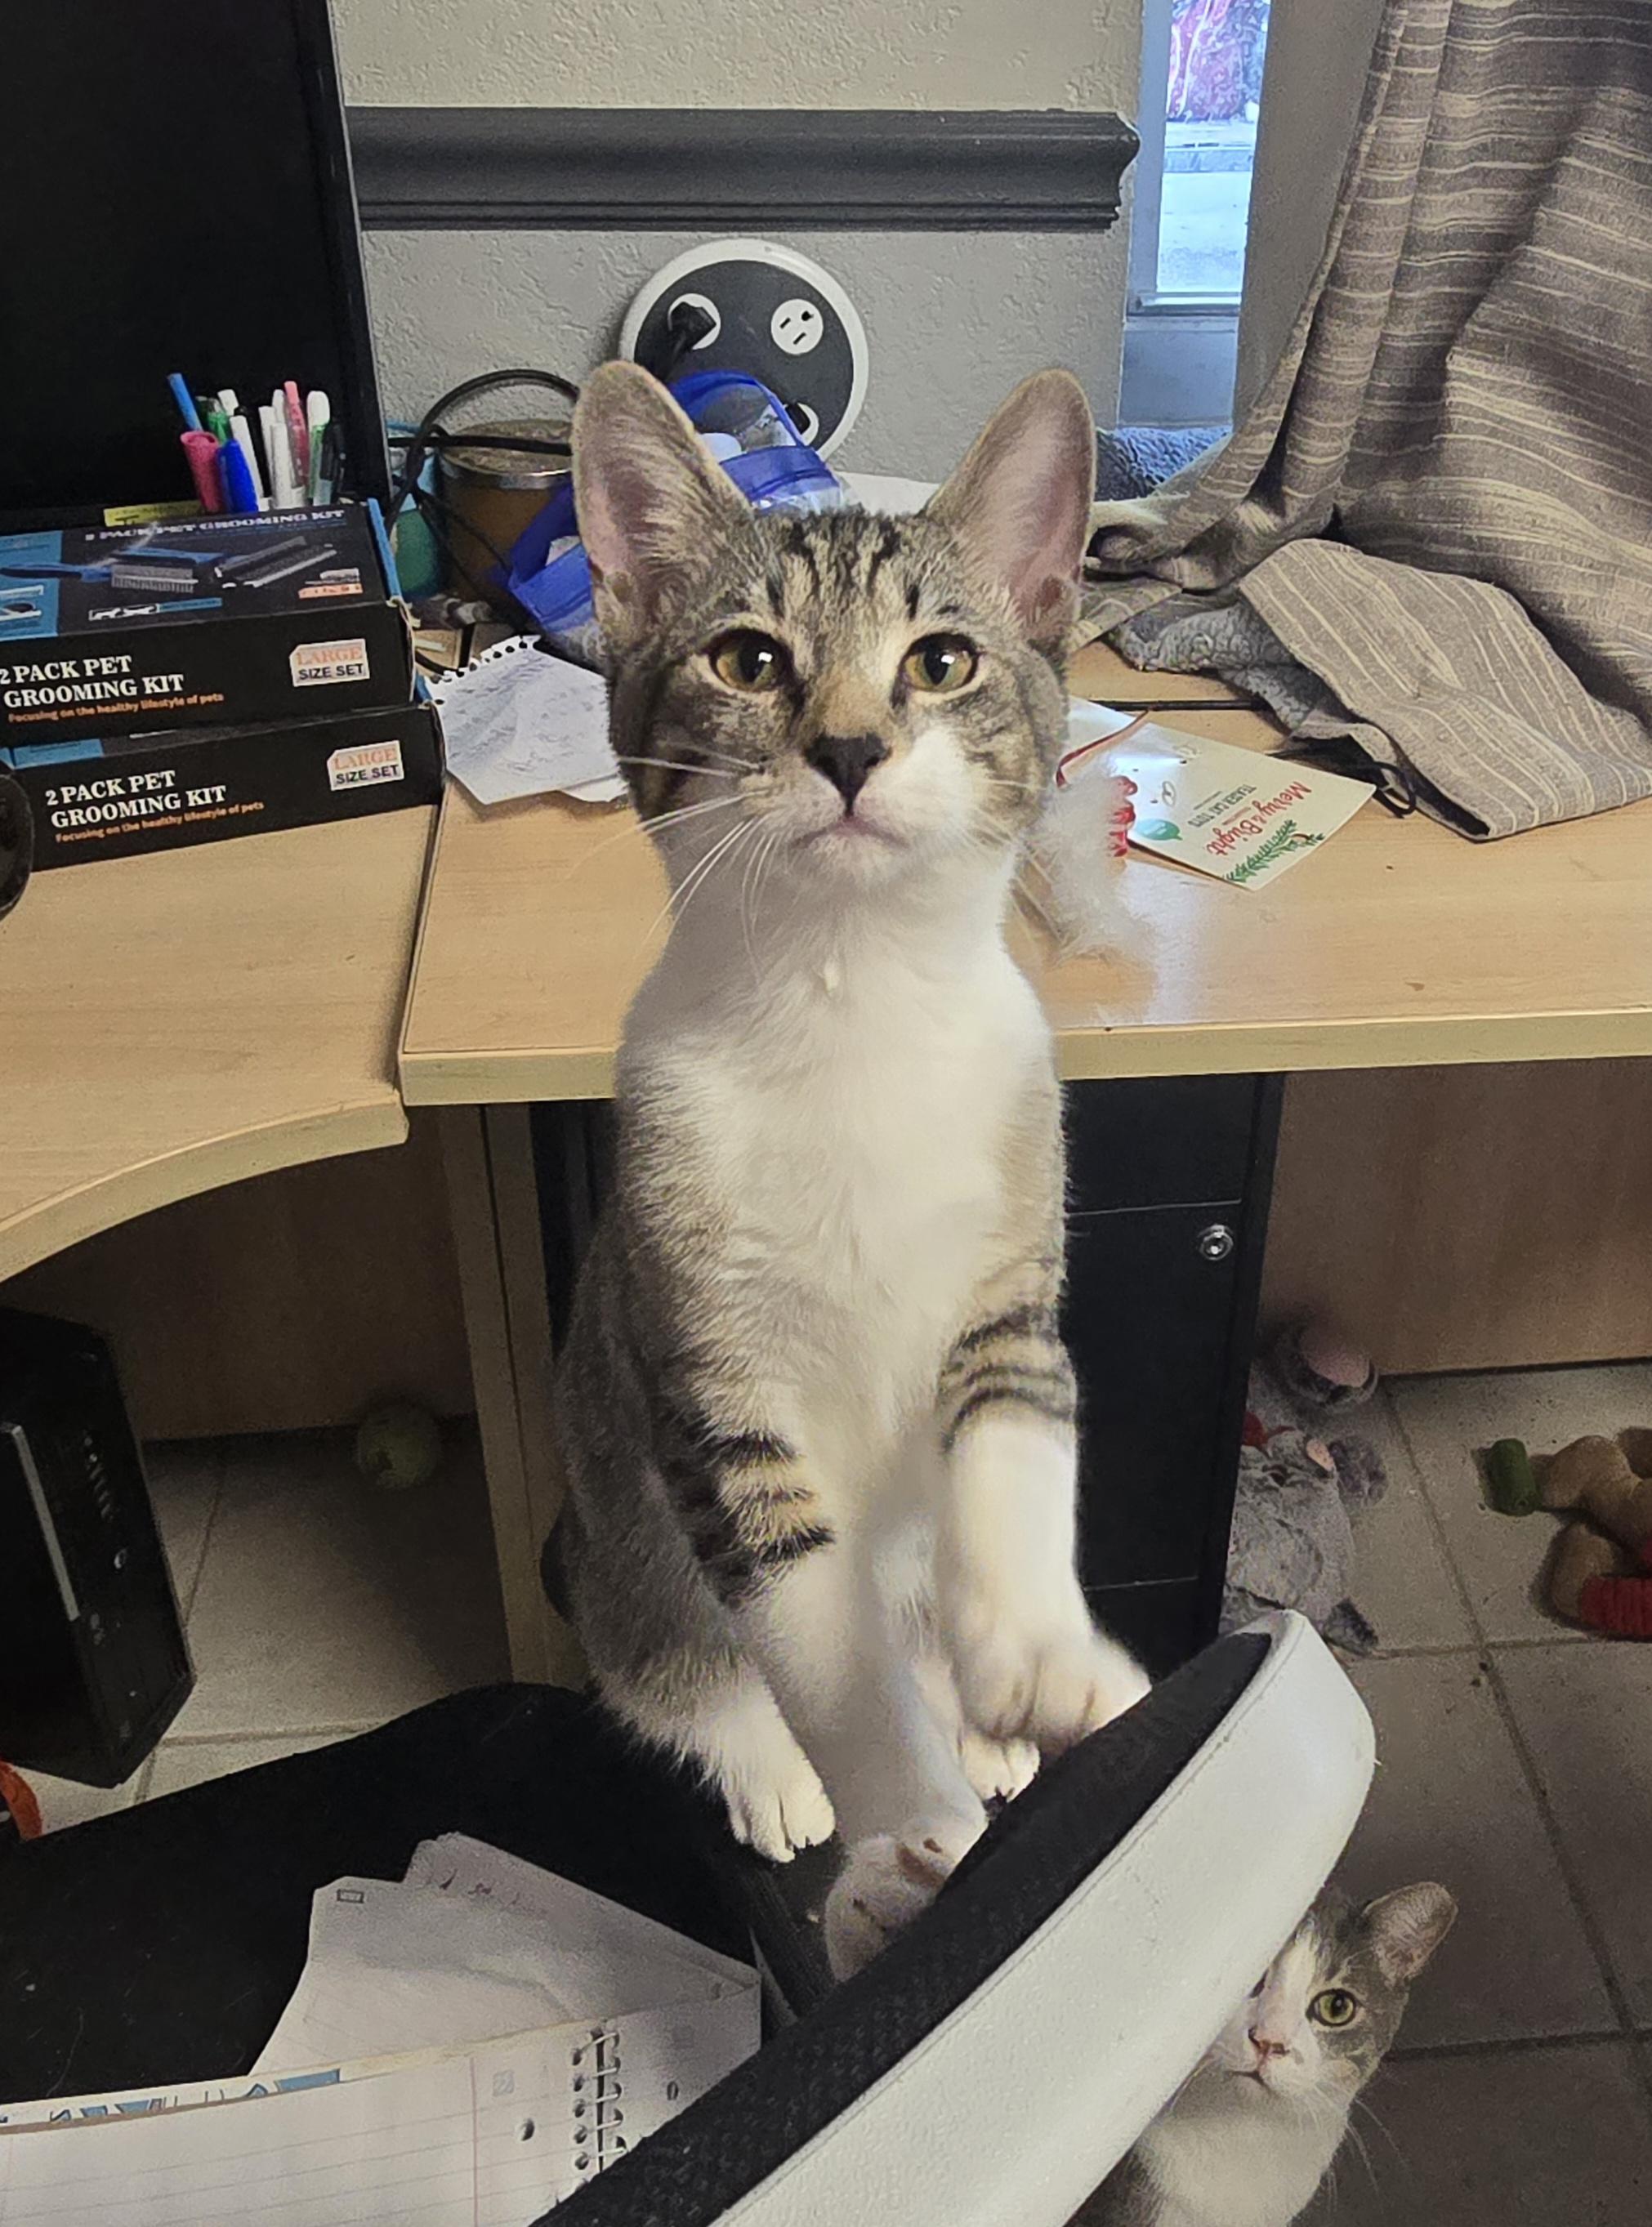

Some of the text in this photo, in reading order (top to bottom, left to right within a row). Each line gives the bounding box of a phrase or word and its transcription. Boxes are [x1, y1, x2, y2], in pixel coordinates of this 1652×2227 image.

[199, 512, 309, 530] GROOMING
[312, 509, 345, 520] KIT
[0, 655, 132, 685] 2 PACK PET
[297, 646, 364, 666] LARGE
[298, 663, 364, 681] SIZE SET
[3, 674, 185, 708] GROOMING KIT
[8, 693, 225, 722] Focusing on the healthy lifestyle of pets
[333, 748, 398, 770] LARGE
[336, 764, 400, 784] SIZE SET
[45, 770, 176, 806] 2 PACK PET
[1251, 781, 1312, 817] Merry
[51, 785, 226, 828] GROOMING KIT
[55, 801, 265, 843] Focusing on the healthy lifestyle of pets
[1206, 819, 1263, 855] Bright
